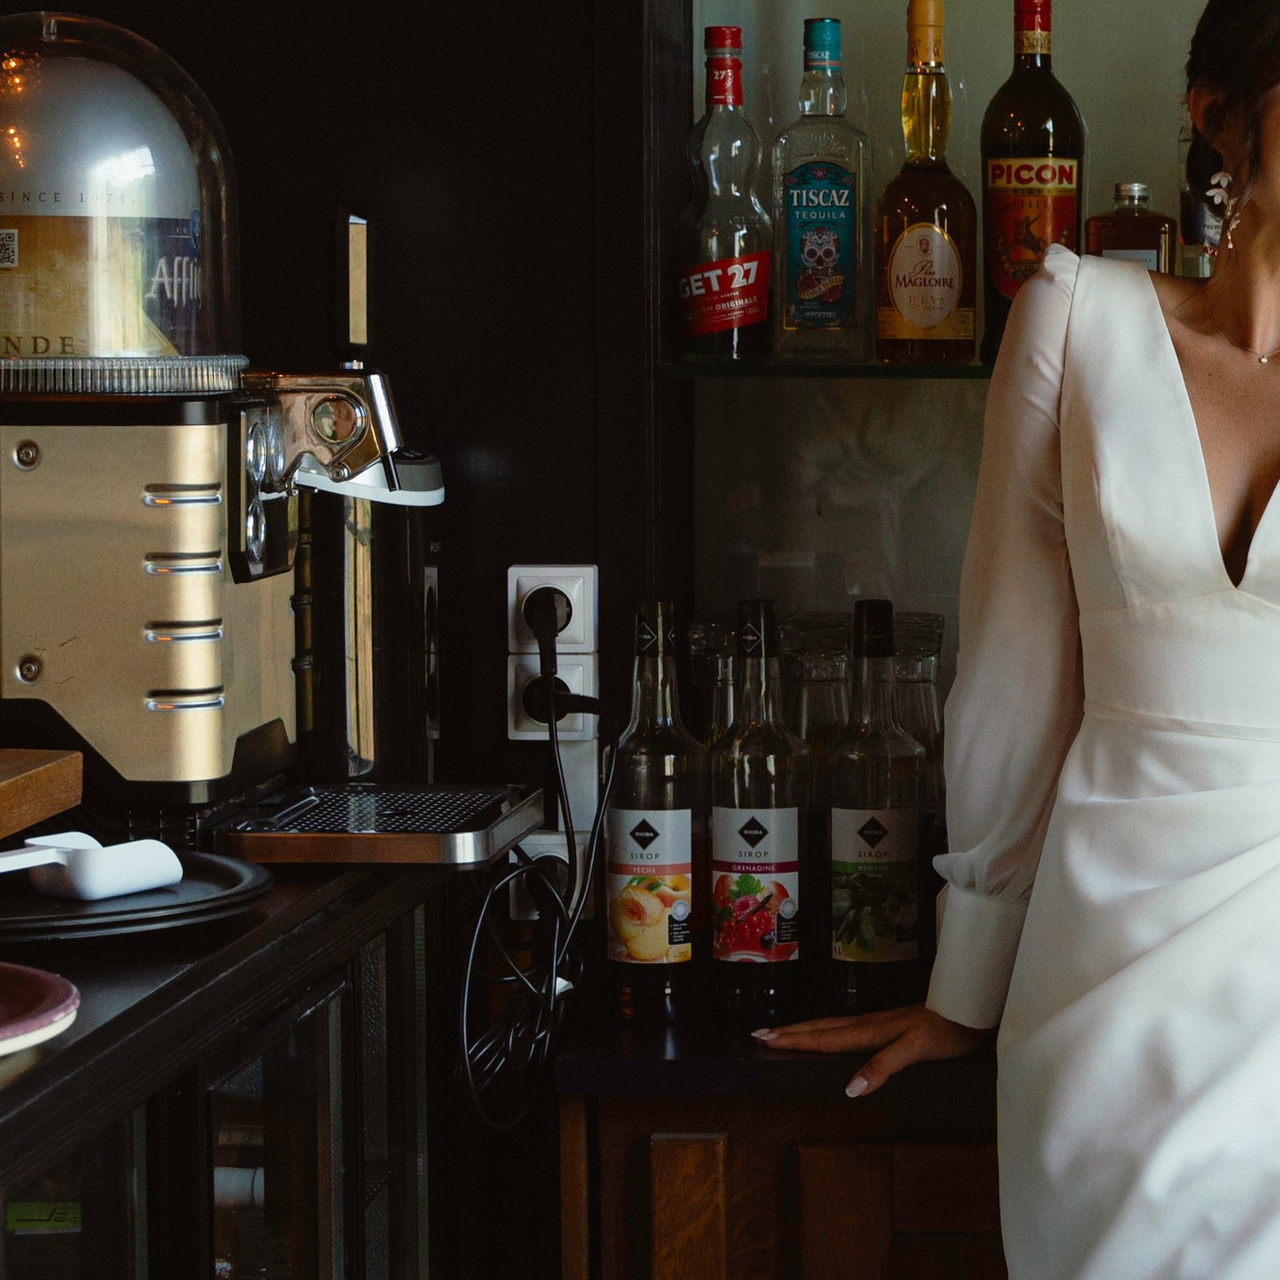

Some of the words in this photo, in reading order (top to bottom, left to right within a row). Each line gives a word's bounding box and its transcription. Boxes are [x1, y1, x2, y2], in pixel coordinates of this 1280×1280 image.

[713, 71, 726, 79] 27
[990, 164, 1074, 185] PICON
[0, 192, 61, 202] SINCE
[789, 190, 850, 207] TISCAZ
[795, 210, 846, 219] TEQUILA
[145, 256, 202, 308] Affli
[678, 269, 723, 298] GET
[727, 260, 759, 290] 27
[894, 275, 955, 289] MAGLOIRE
[715, 295, 758, 311] ORIGINALE
[4, 336, 75, 355] NDE
[630, 852, 660, 860] SIROP
